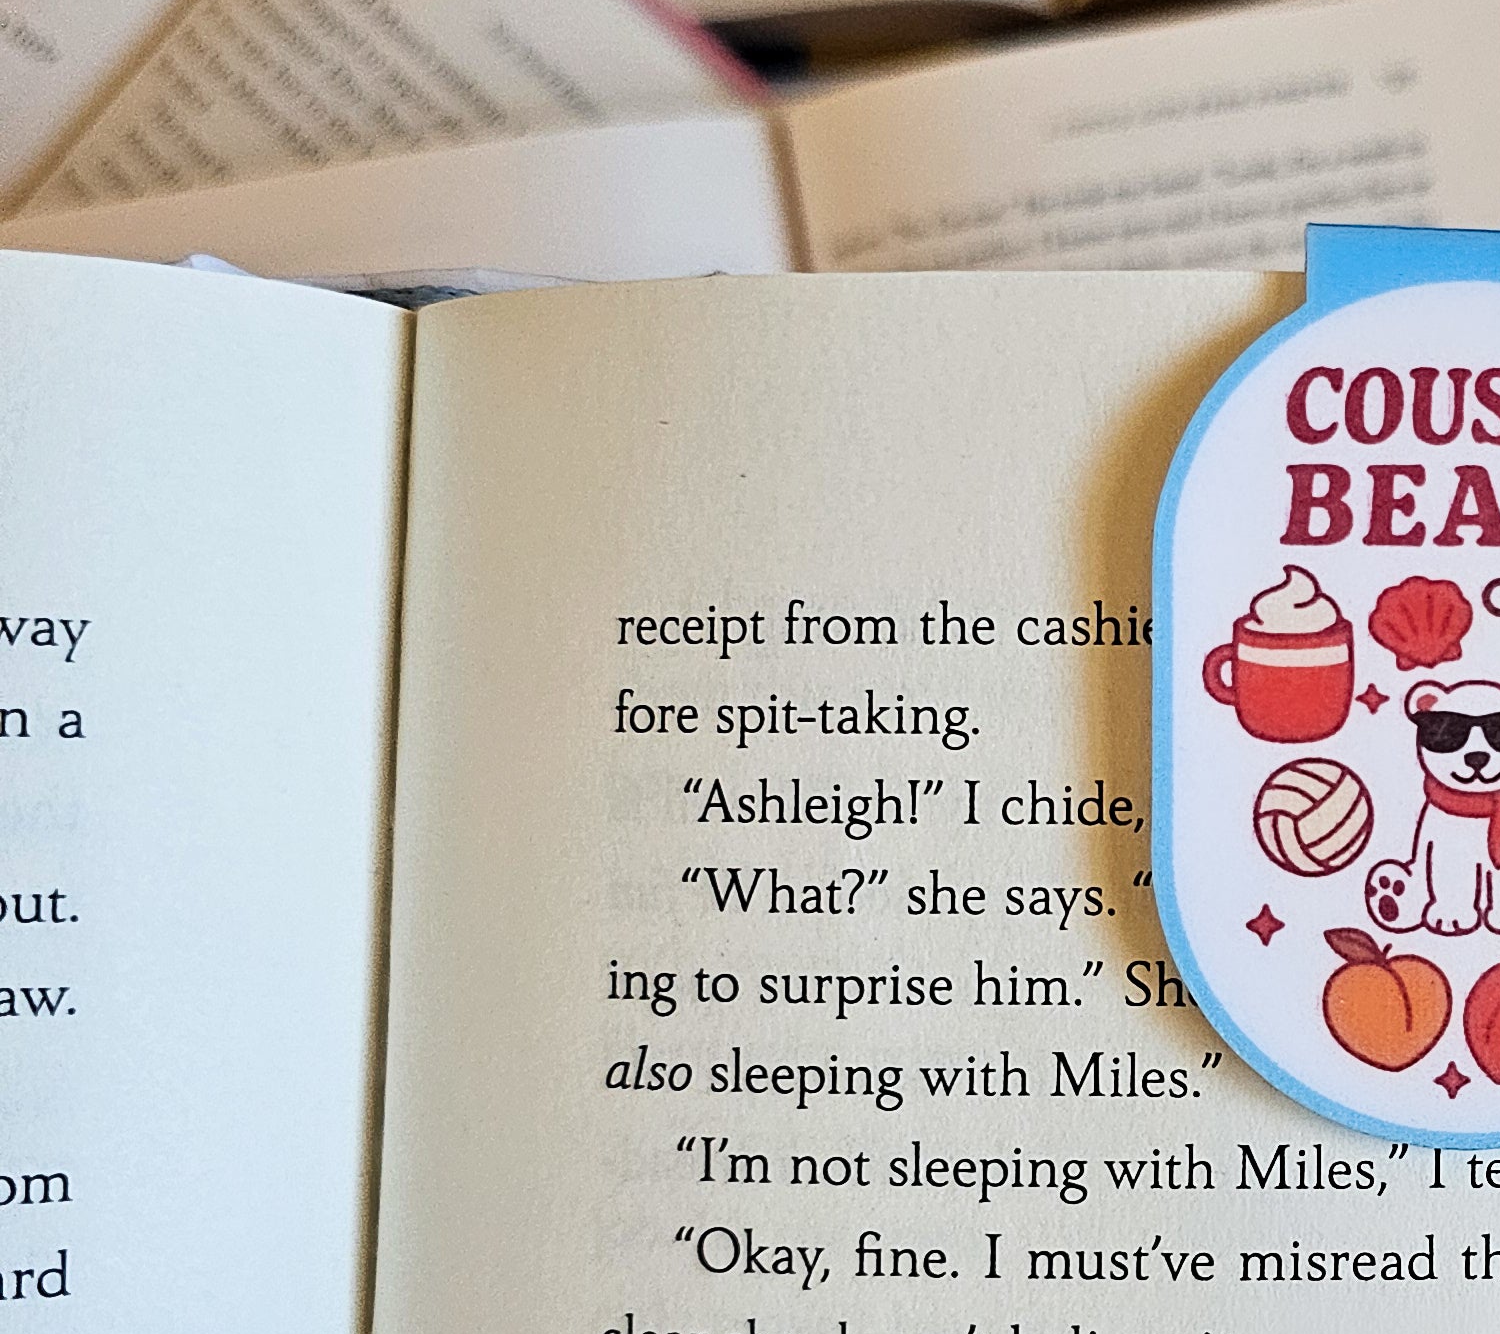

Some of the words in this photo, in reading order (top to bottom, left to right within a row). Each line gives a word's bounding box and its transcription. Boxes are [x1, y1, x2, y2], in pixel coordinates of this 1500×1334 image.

[615, 605, 766, 660] receipt
[783, 598, 899, 645] from
[919, 599, 995, 646] the
[58, 708, 87, 739] a
[613, 688, 699, 734] fore
[716, 688, 980, 751] spit-taking.
[683, 777, 944, 841] “Ashleigh!”
[963, 779, 981, 825] I
[1001, 779, 1145, 834] chide,
[681, 866, 889, 915] “What?”
[907, 868, 986, 916] she
[1005, 886, 1116, 931] says.
[606, 959, 678, 1018] ing
[693, 967, 740, 1003] to
[759, 964, 953, 1020] surprise
[973, 959, 1104, 1007] him.”
[605, 1044, 693, 1092] also
[710, 1046, 904, 1112] sleeping
[918, 1050, 1031, 1097] with
[1049, 1051, 1223, 1099] Miles.”
[676, 1135, 773, 1184] “I’m
[789, 1151, 871, 1187] not
[888, 1140, 1089, 1205] sleeping
[1103, 1143, 1216, 1190] with
[1235, 1143, 1409, 1197] Miles,”
[1428, 1149, 1447, 1189] I
[672, 1225, 831, 1291] “Okay,
[854, 1230, 959, 1279] fine.
[984, 1233, 1003, 1279] I
[1027, 1234, 1215, 1282] must’ve
[1239, 1233, 1439, 1282] misread
